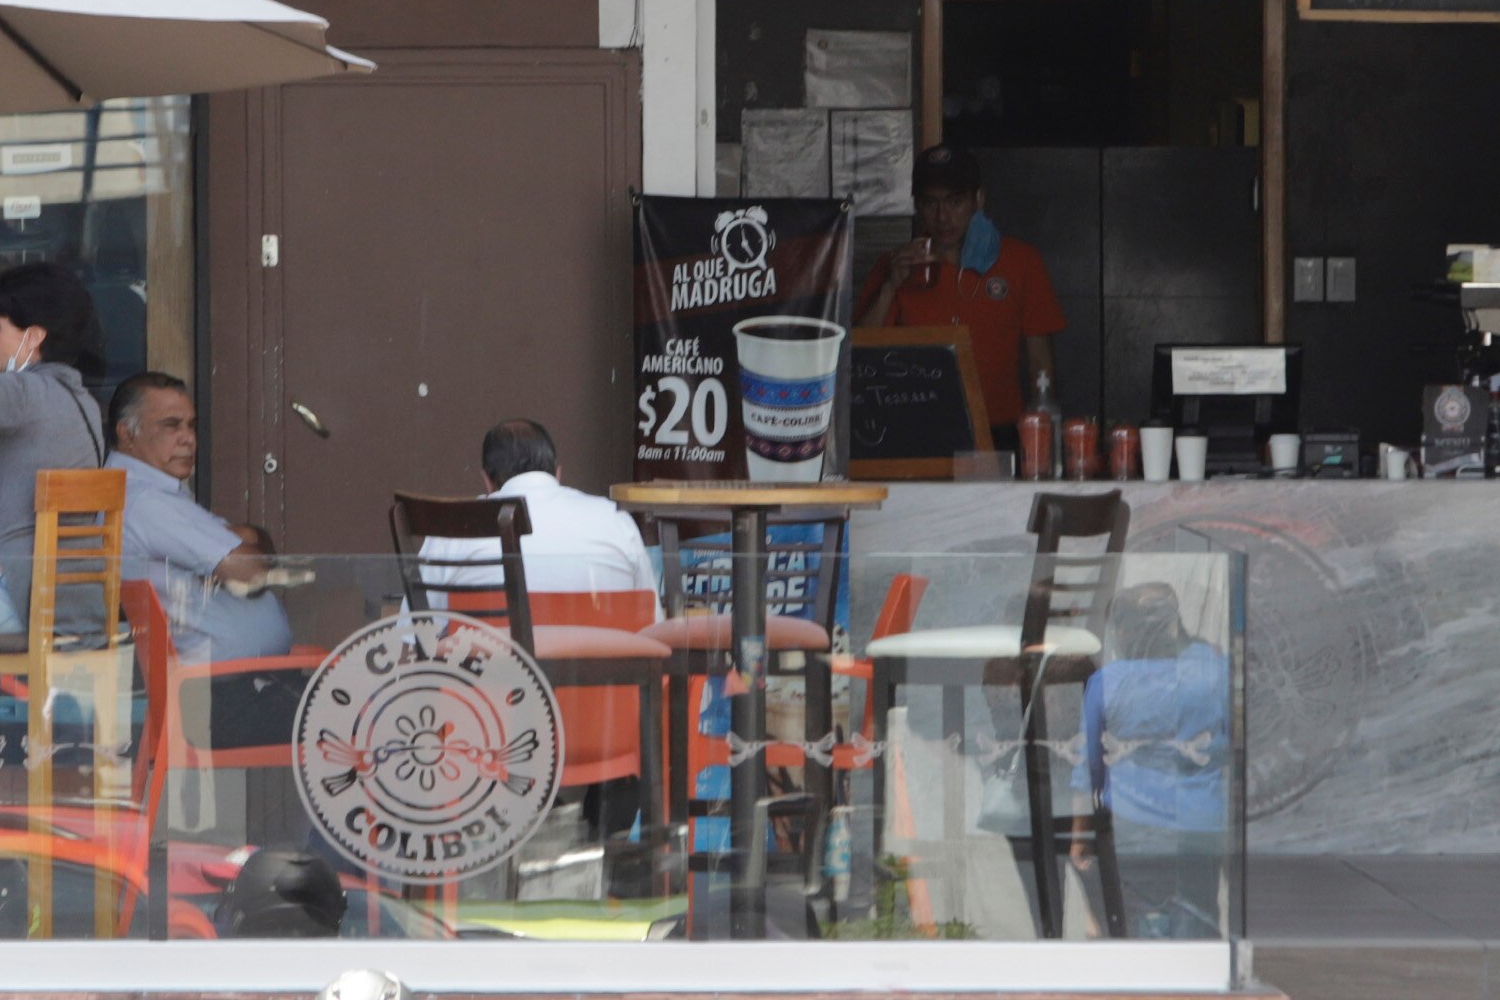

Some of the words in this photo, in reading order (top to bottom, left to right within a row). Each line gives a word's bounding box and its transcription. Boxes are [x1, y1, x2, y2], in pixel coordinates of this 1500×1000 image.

[672, 263, 691, 284] AL
[693, 257, 725, 283] QUE
[670, 267, 777, 312] MADRUGA
[665, 335, 700, 356] CAFÉ
[641, 355, 724, 375] AMERICANO
[638, 376, 728, 448] $20
[637, 444, 663, 460] 8am
[674, 446, 726, 463] 11:00am
[365, 634, 493, 678] CAFE
